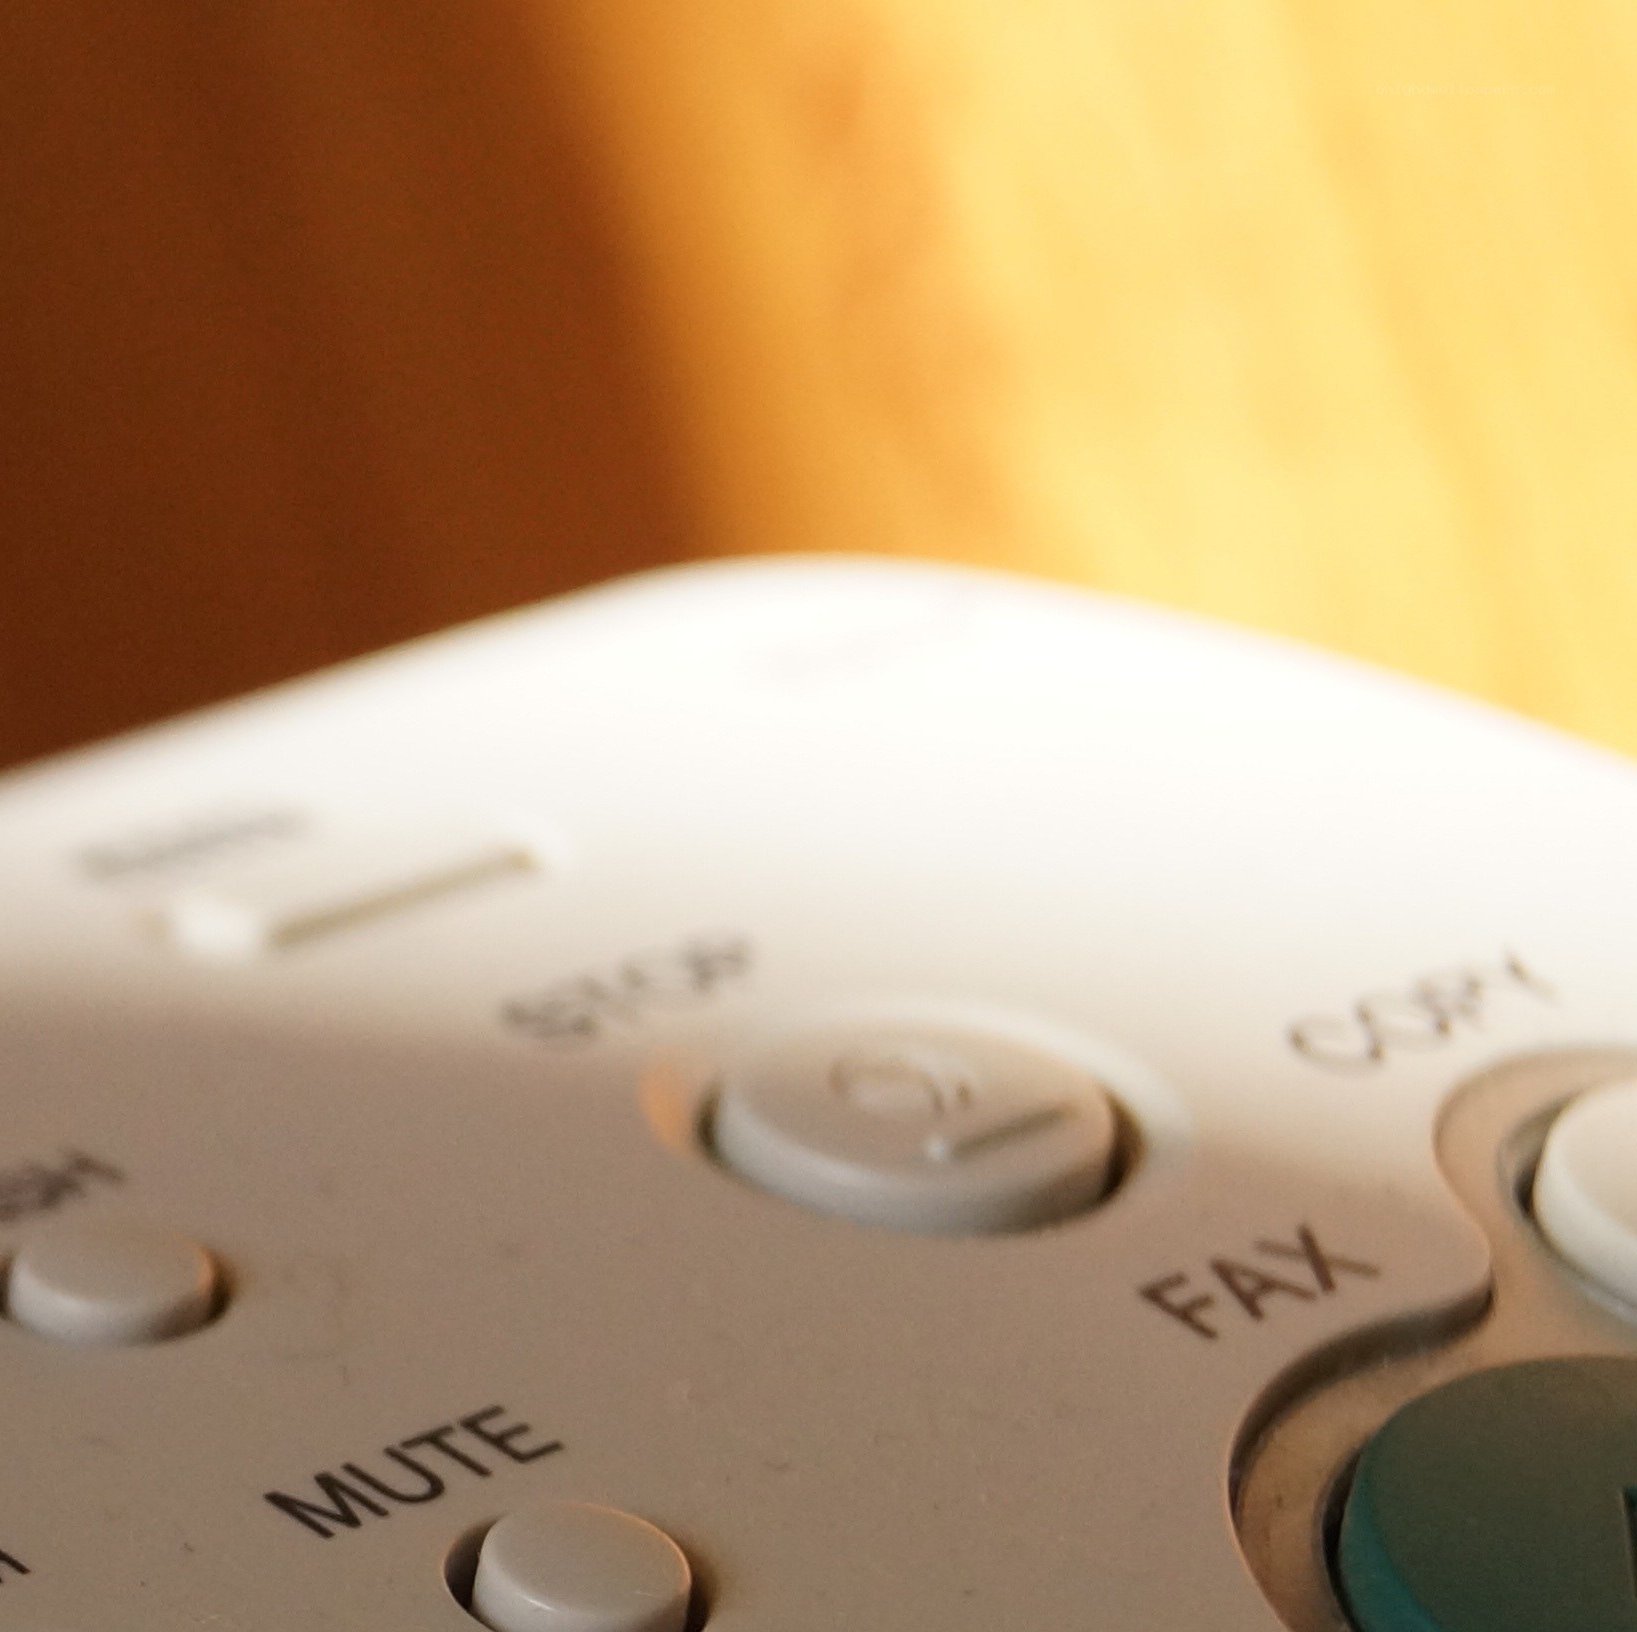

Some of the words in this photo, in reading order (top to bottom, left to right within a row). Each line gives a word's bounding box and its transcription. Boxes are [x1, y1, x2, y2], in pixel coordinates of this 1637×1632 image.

[1286, 947, 1556, 1078] COPY
[1137, 1224, 1381, 1341] FAX
[263, 1405, 565, 1539] MUTE
